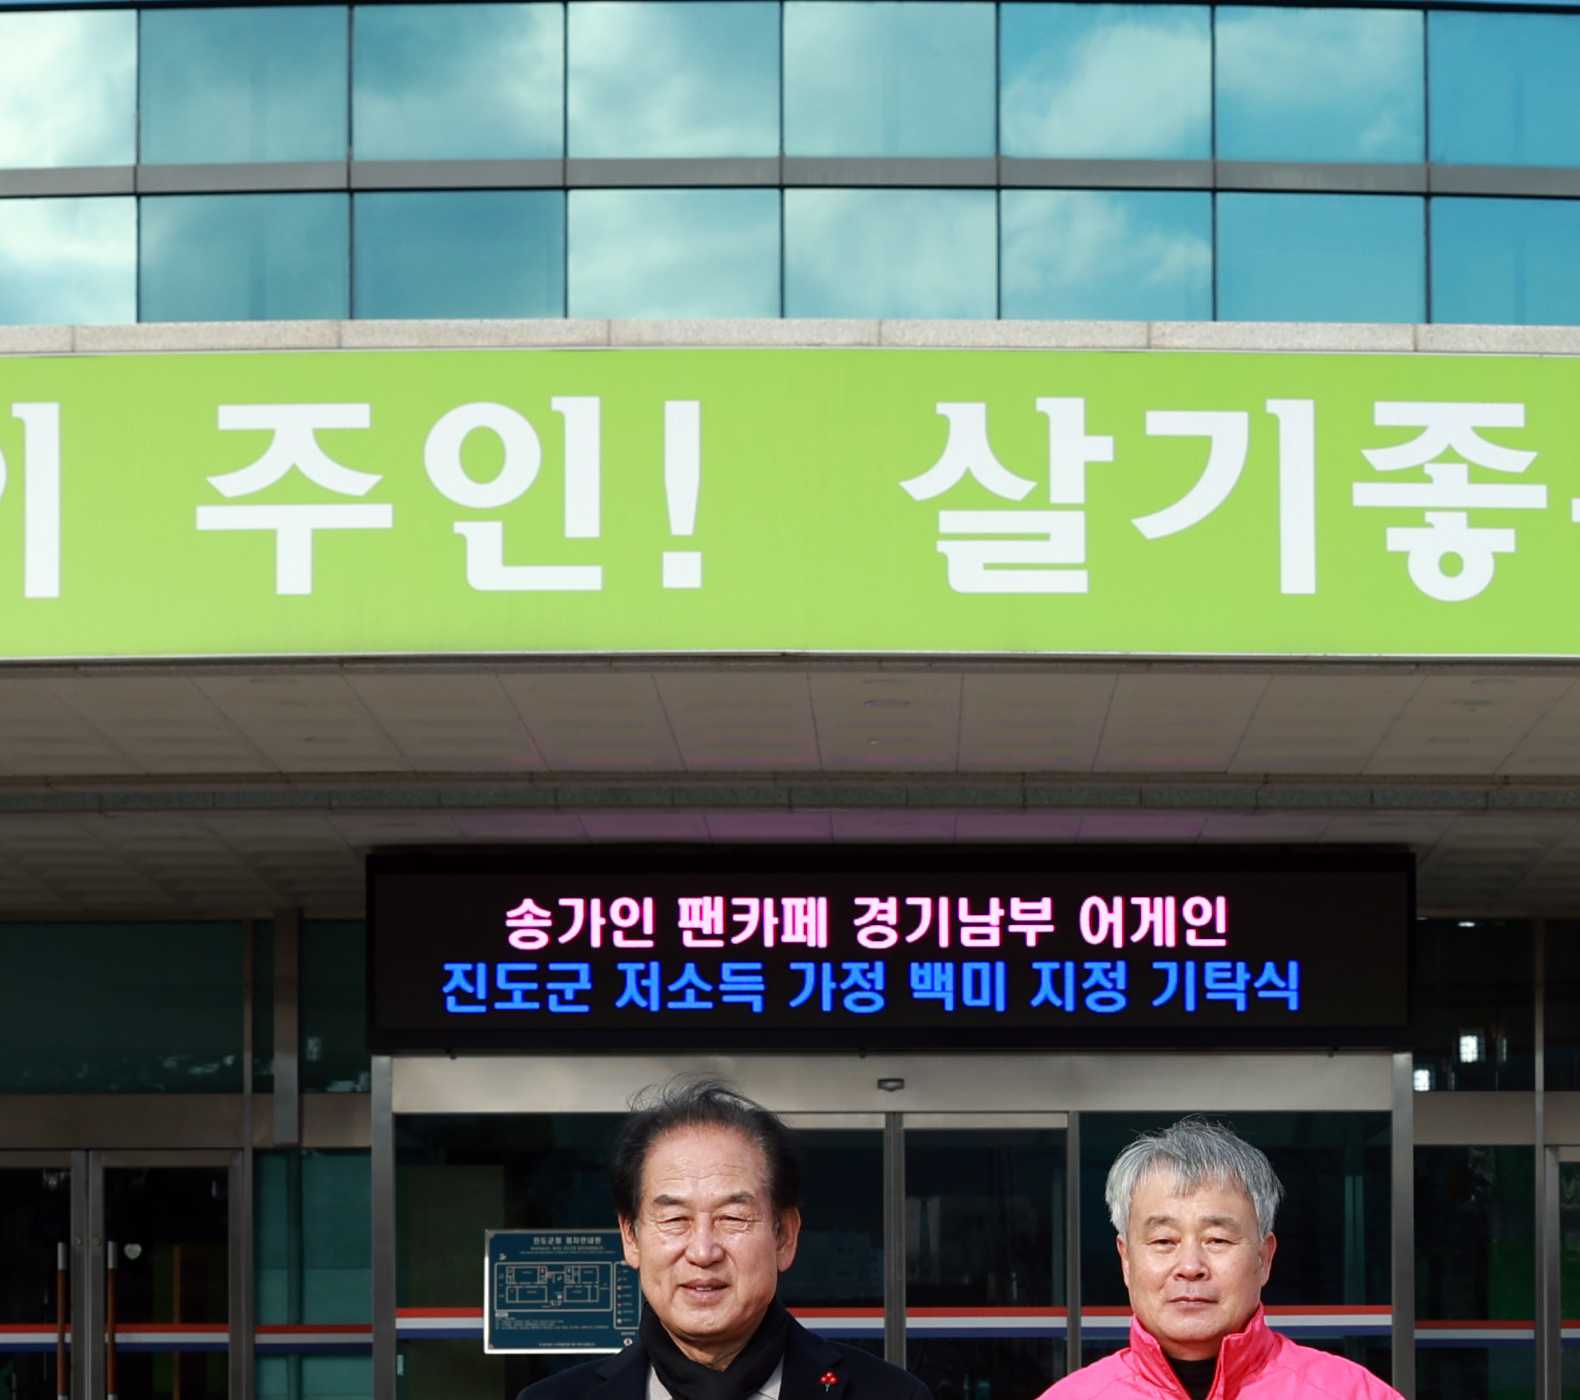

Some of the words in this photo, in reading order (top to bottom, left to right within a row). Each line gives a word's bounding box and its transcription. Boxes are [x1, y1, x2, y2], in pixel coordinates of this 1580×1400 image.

[196, 395, 702, 595] 주인!
[504, 898, 655, 950] 송가인
[678, 896, 829, 948] 팬카페
[852, 898, 1053, 951] 경기남부
[1078, 896, 1230, 948] 어게인
[441, 961, 593, 1014] 진도군
[615, 961, 766, 1014] 저소득
[789, 961, 887, 1014] 가정
[908, 961, 1008, 1014] 백미
[1029, 961, 1128, 1014] 지정
[1149, 961, 1302, 1014] 기탁식
